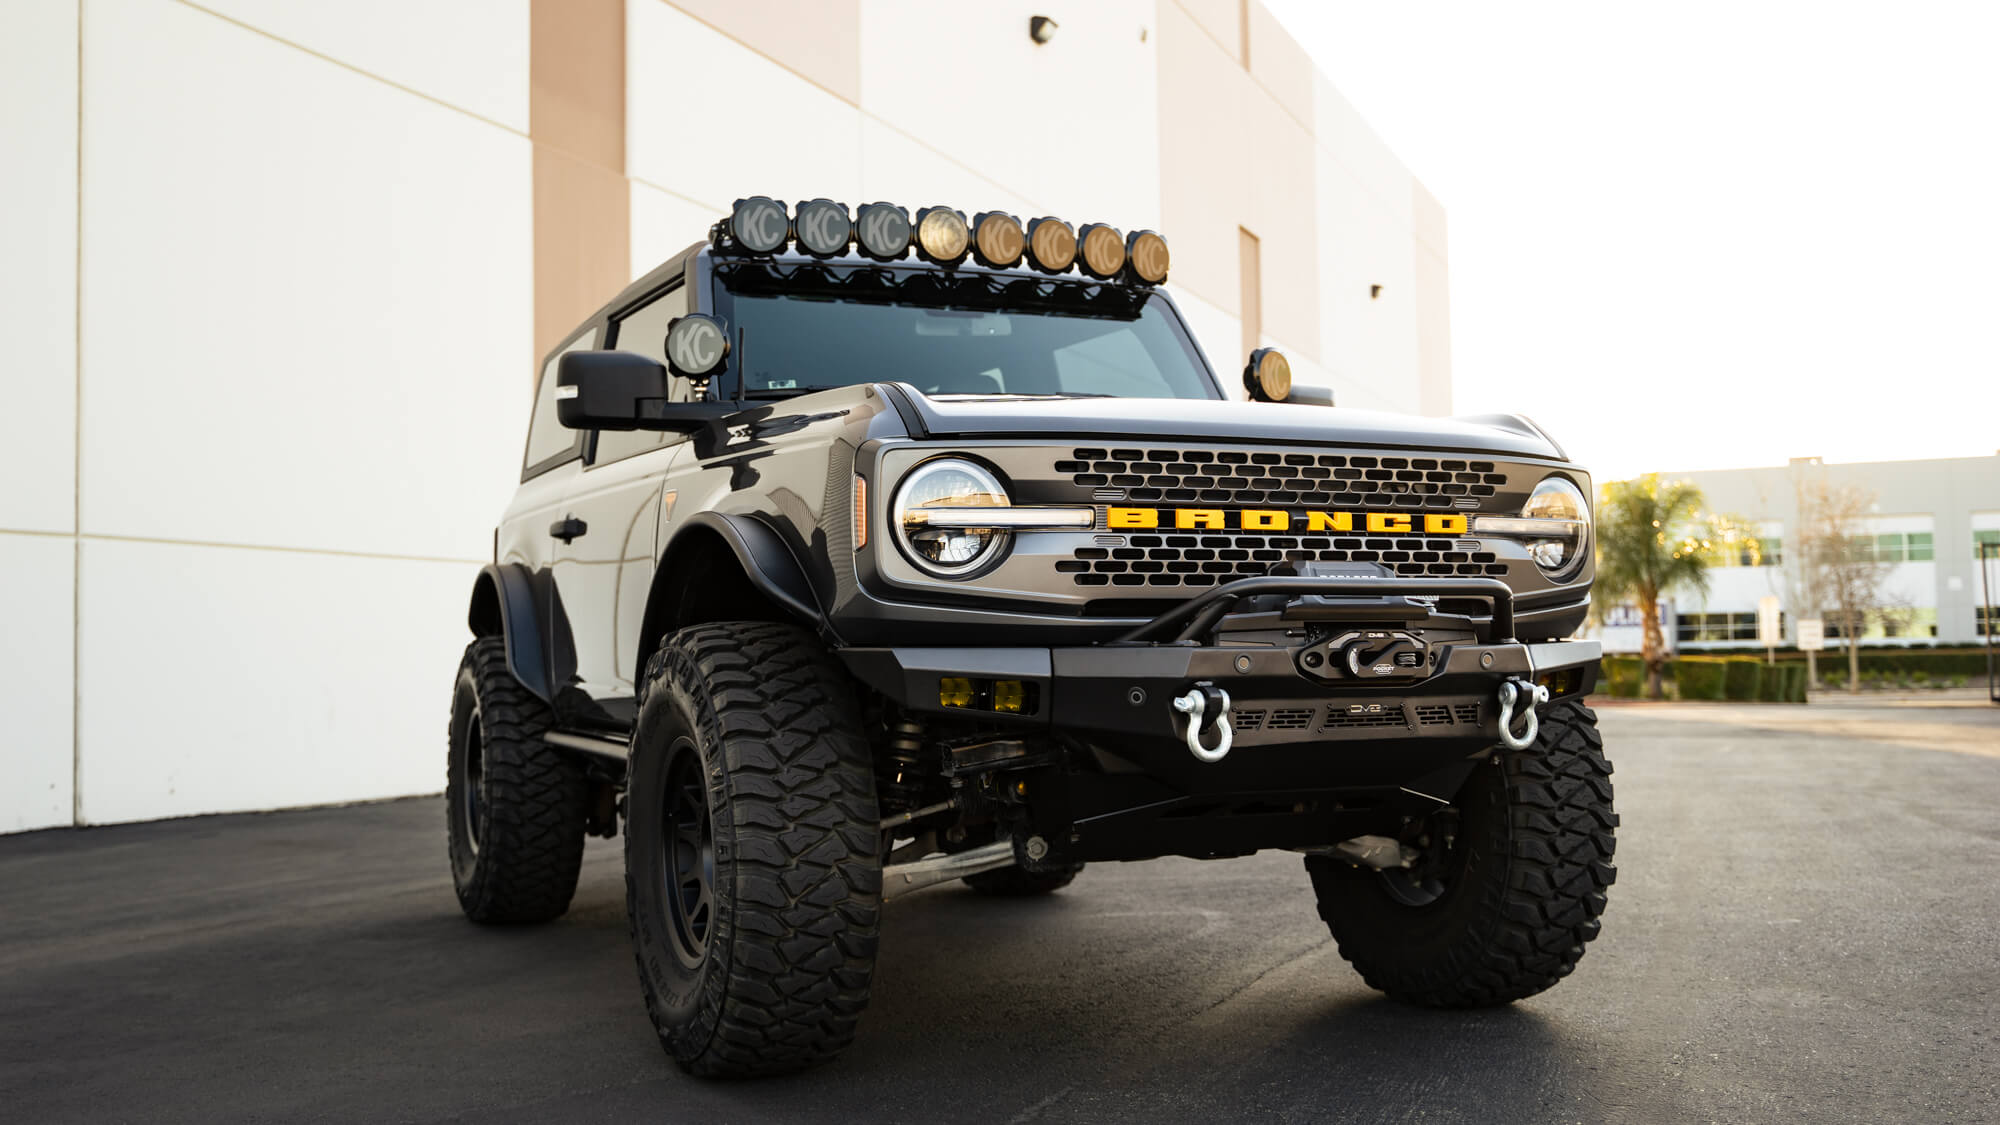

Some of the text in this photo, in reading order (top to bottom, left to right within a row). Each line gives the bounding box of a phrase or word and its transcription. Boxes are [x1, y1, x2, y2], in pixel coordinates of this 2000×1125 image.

[743, 204, 779, 247] KC
[806, 207, 841, 249] KC
[867, 210, 901, 251] KC
[928, 213, 962, 254] KC
[984, 219, 1017, 259] KC
[1038, 225, 1068, 264] KC
[1091, 231, 1118, 270] KC
[1138, 237, 1164, 276] KC
[677, 323, 715, 369] KC
[1264, 356, 1288, 396] KC
[1107, 507, 1467, 534] BRONCO
